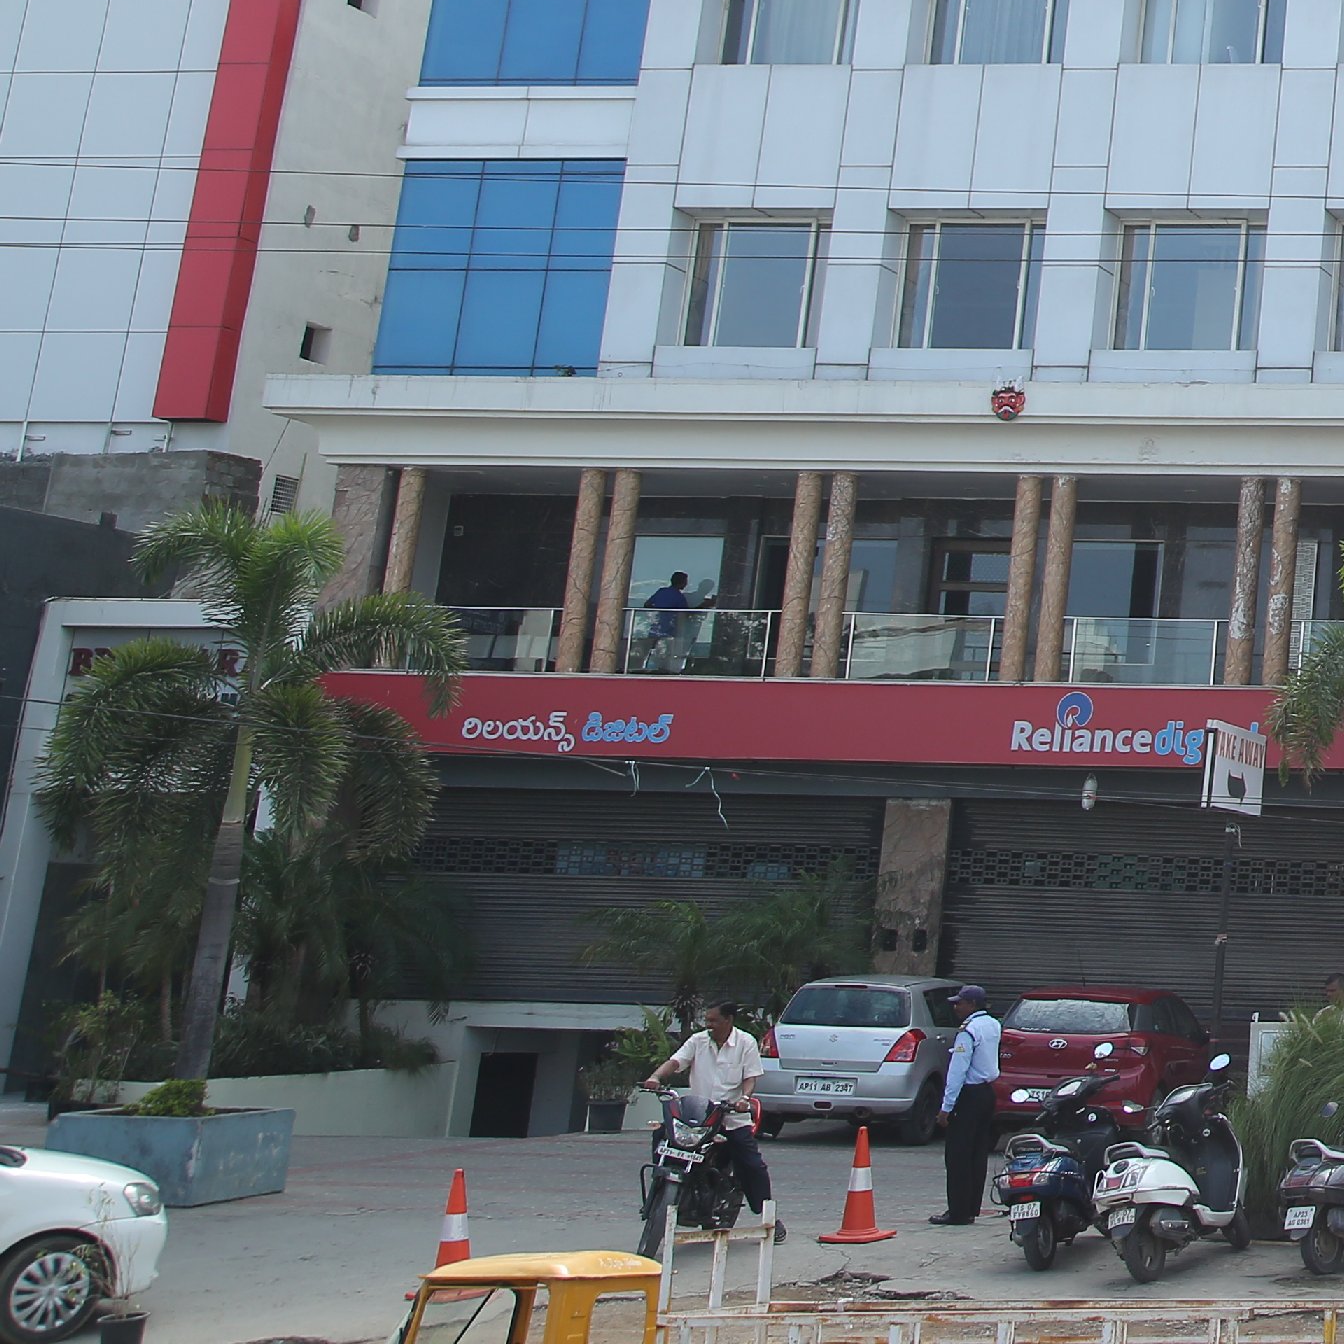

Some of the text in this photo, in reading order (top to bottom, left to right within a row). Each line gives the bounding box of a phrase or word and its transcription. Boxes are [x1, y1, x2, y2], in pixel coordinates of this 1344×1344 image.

[461, 711, 675, 753] రిలయన్స్ డిజిటల్
[1238, 738, 1265, 768] AWAY
